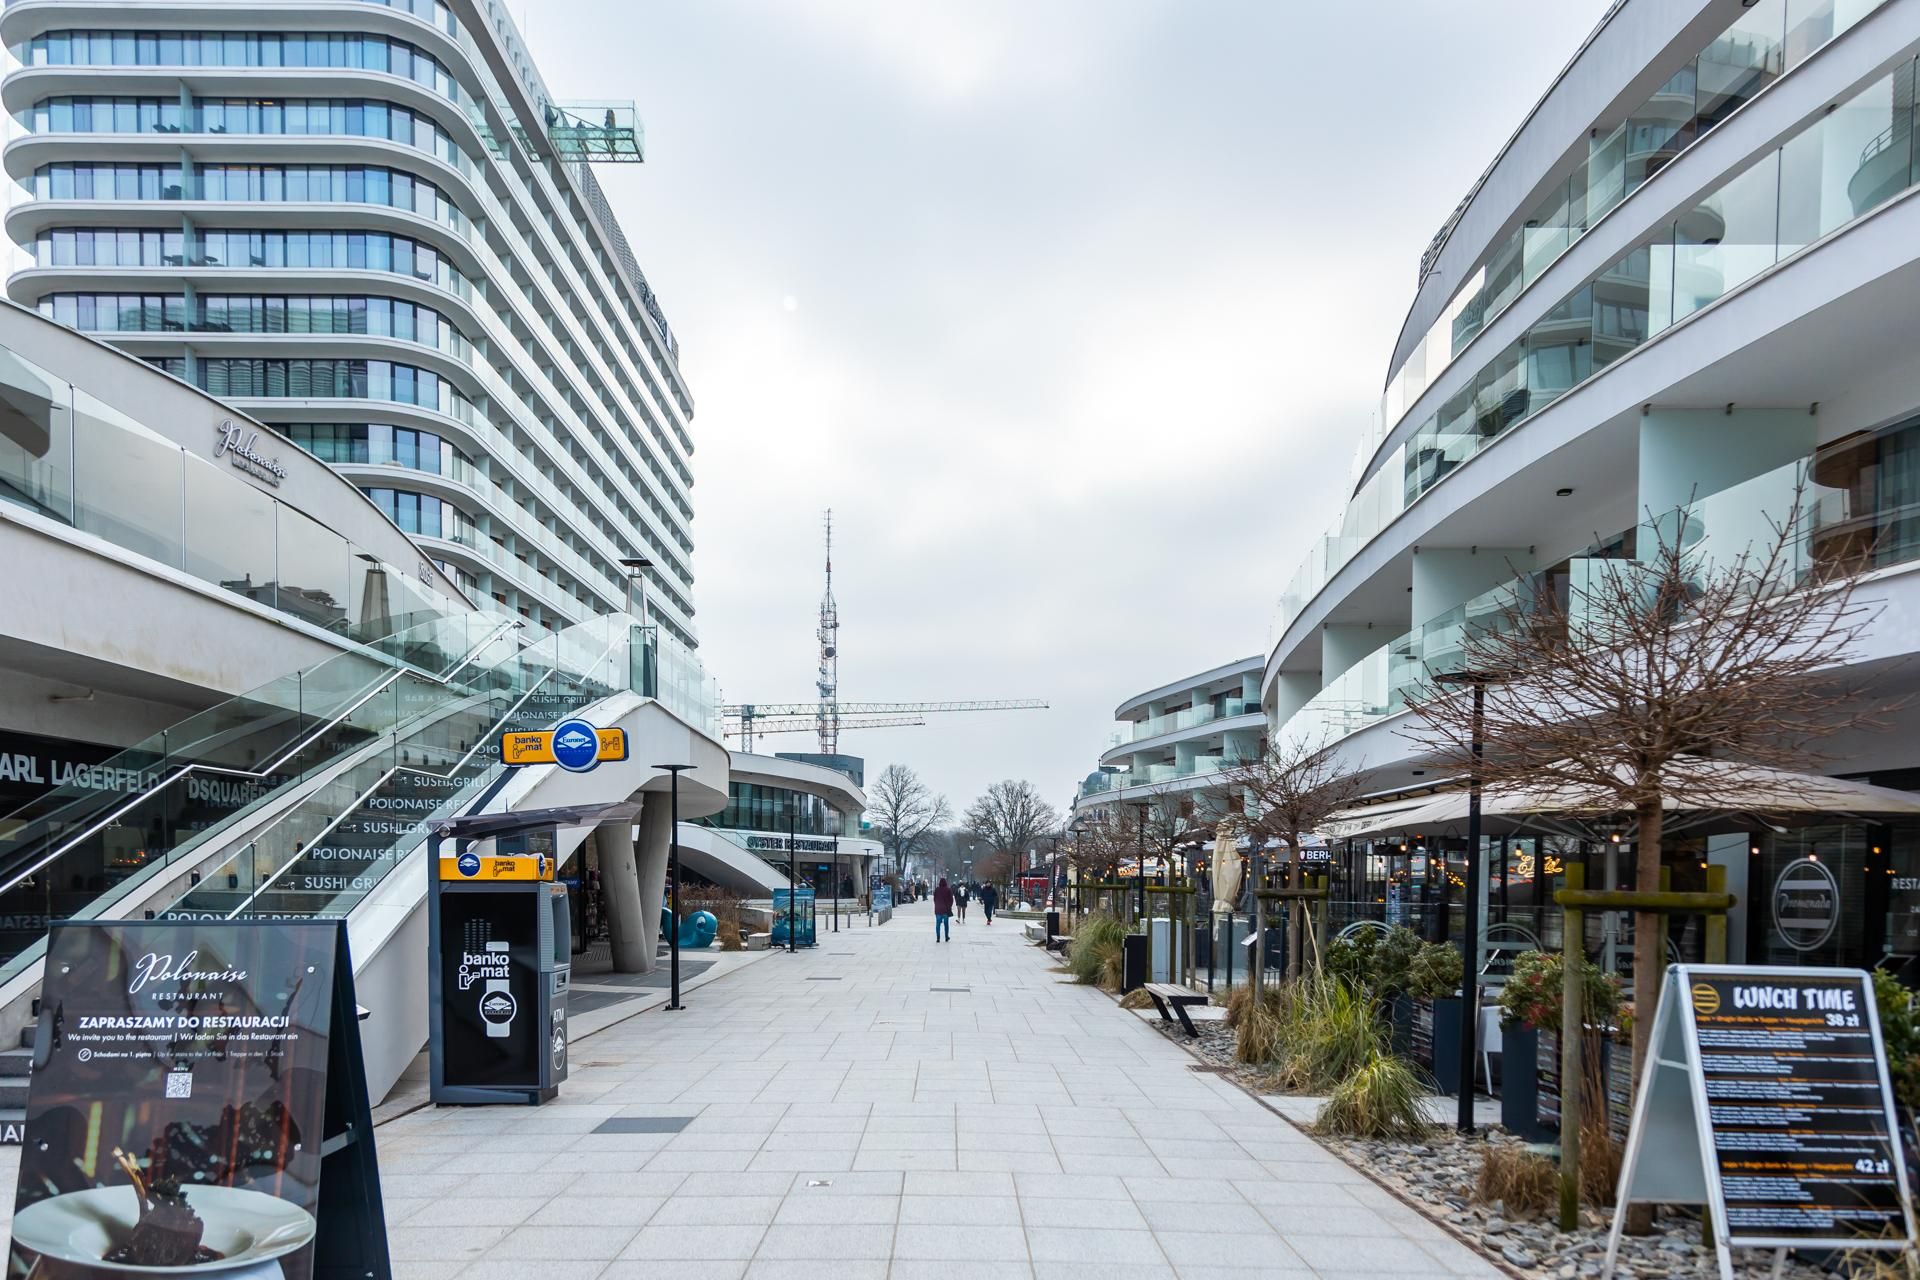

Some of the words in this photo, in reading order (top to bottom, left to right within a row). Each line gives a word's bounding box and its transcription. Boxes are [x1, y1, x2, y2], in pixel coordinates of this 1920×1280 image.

[514, 736, 542, 744] banko
[747, 836, 783, 849] OYSTER
[304, 877, 347, 889] SUSHI
[463, 952, 509, 965] banko
[129, 951, 249, 994] Polonaise
[480, 965, 510, 977] mat
[152, 992, 224, 1001] RESTAURANT
[1733, 986, 1798, 1010] LUNCH
[1802, 988, 1856, 1012] TIME
[79, 1016, 175, 1029] ZAPRASZAMY
[177, 1015, 200, 1028] DO
[202, 1015, 290, 1028] RESTAURACJI
[553, 1008, 565, 1024] ATM
[1825, 1013, 1844, 1027] 38
[67, 1033, 81, 1041] We
[82, 1033, 101, 1041] invite
[102, 1035, 116, 1043] you
[125, 1033, 137, 1041] the
[180, 1032, 194, 1041] Wir
[194, 1032, 215, 1041] laden
[216, 1032, 228, 1041] Sie
[228, 1033, 236, 1041] in
[236, 1032, 250, 1041] das
[250, 1032, 287, 1041] Restaurant
[287, 1033, 298, 1041] ein
[1855, 1158, 1874, 1174] 42
